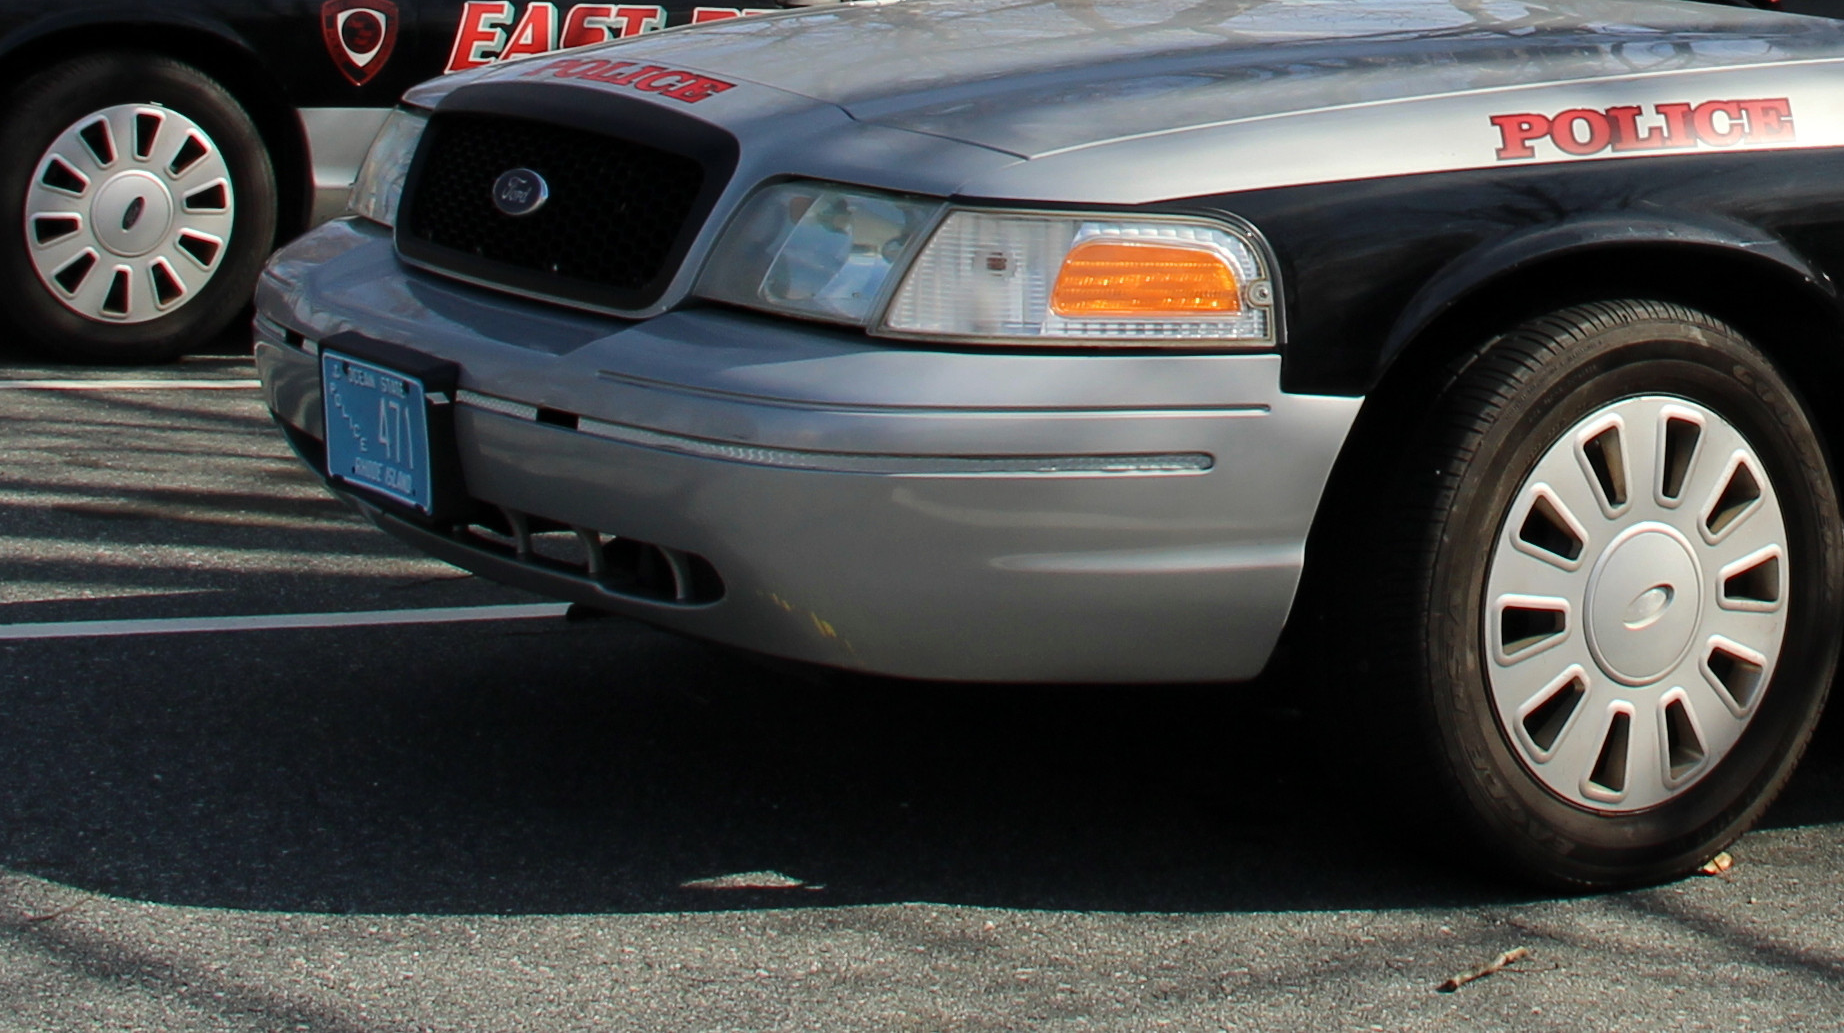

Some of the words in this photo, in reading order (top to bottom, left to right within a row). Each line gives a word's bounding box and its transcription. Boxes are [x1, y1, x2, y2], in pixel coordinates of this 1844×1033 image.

[523, 58, 738, 104] POLICE
[1489, 97, 1797, 161] POLICE
[329, 382, 368, 452] POLICE
[379, 397, 414, 470] 471
